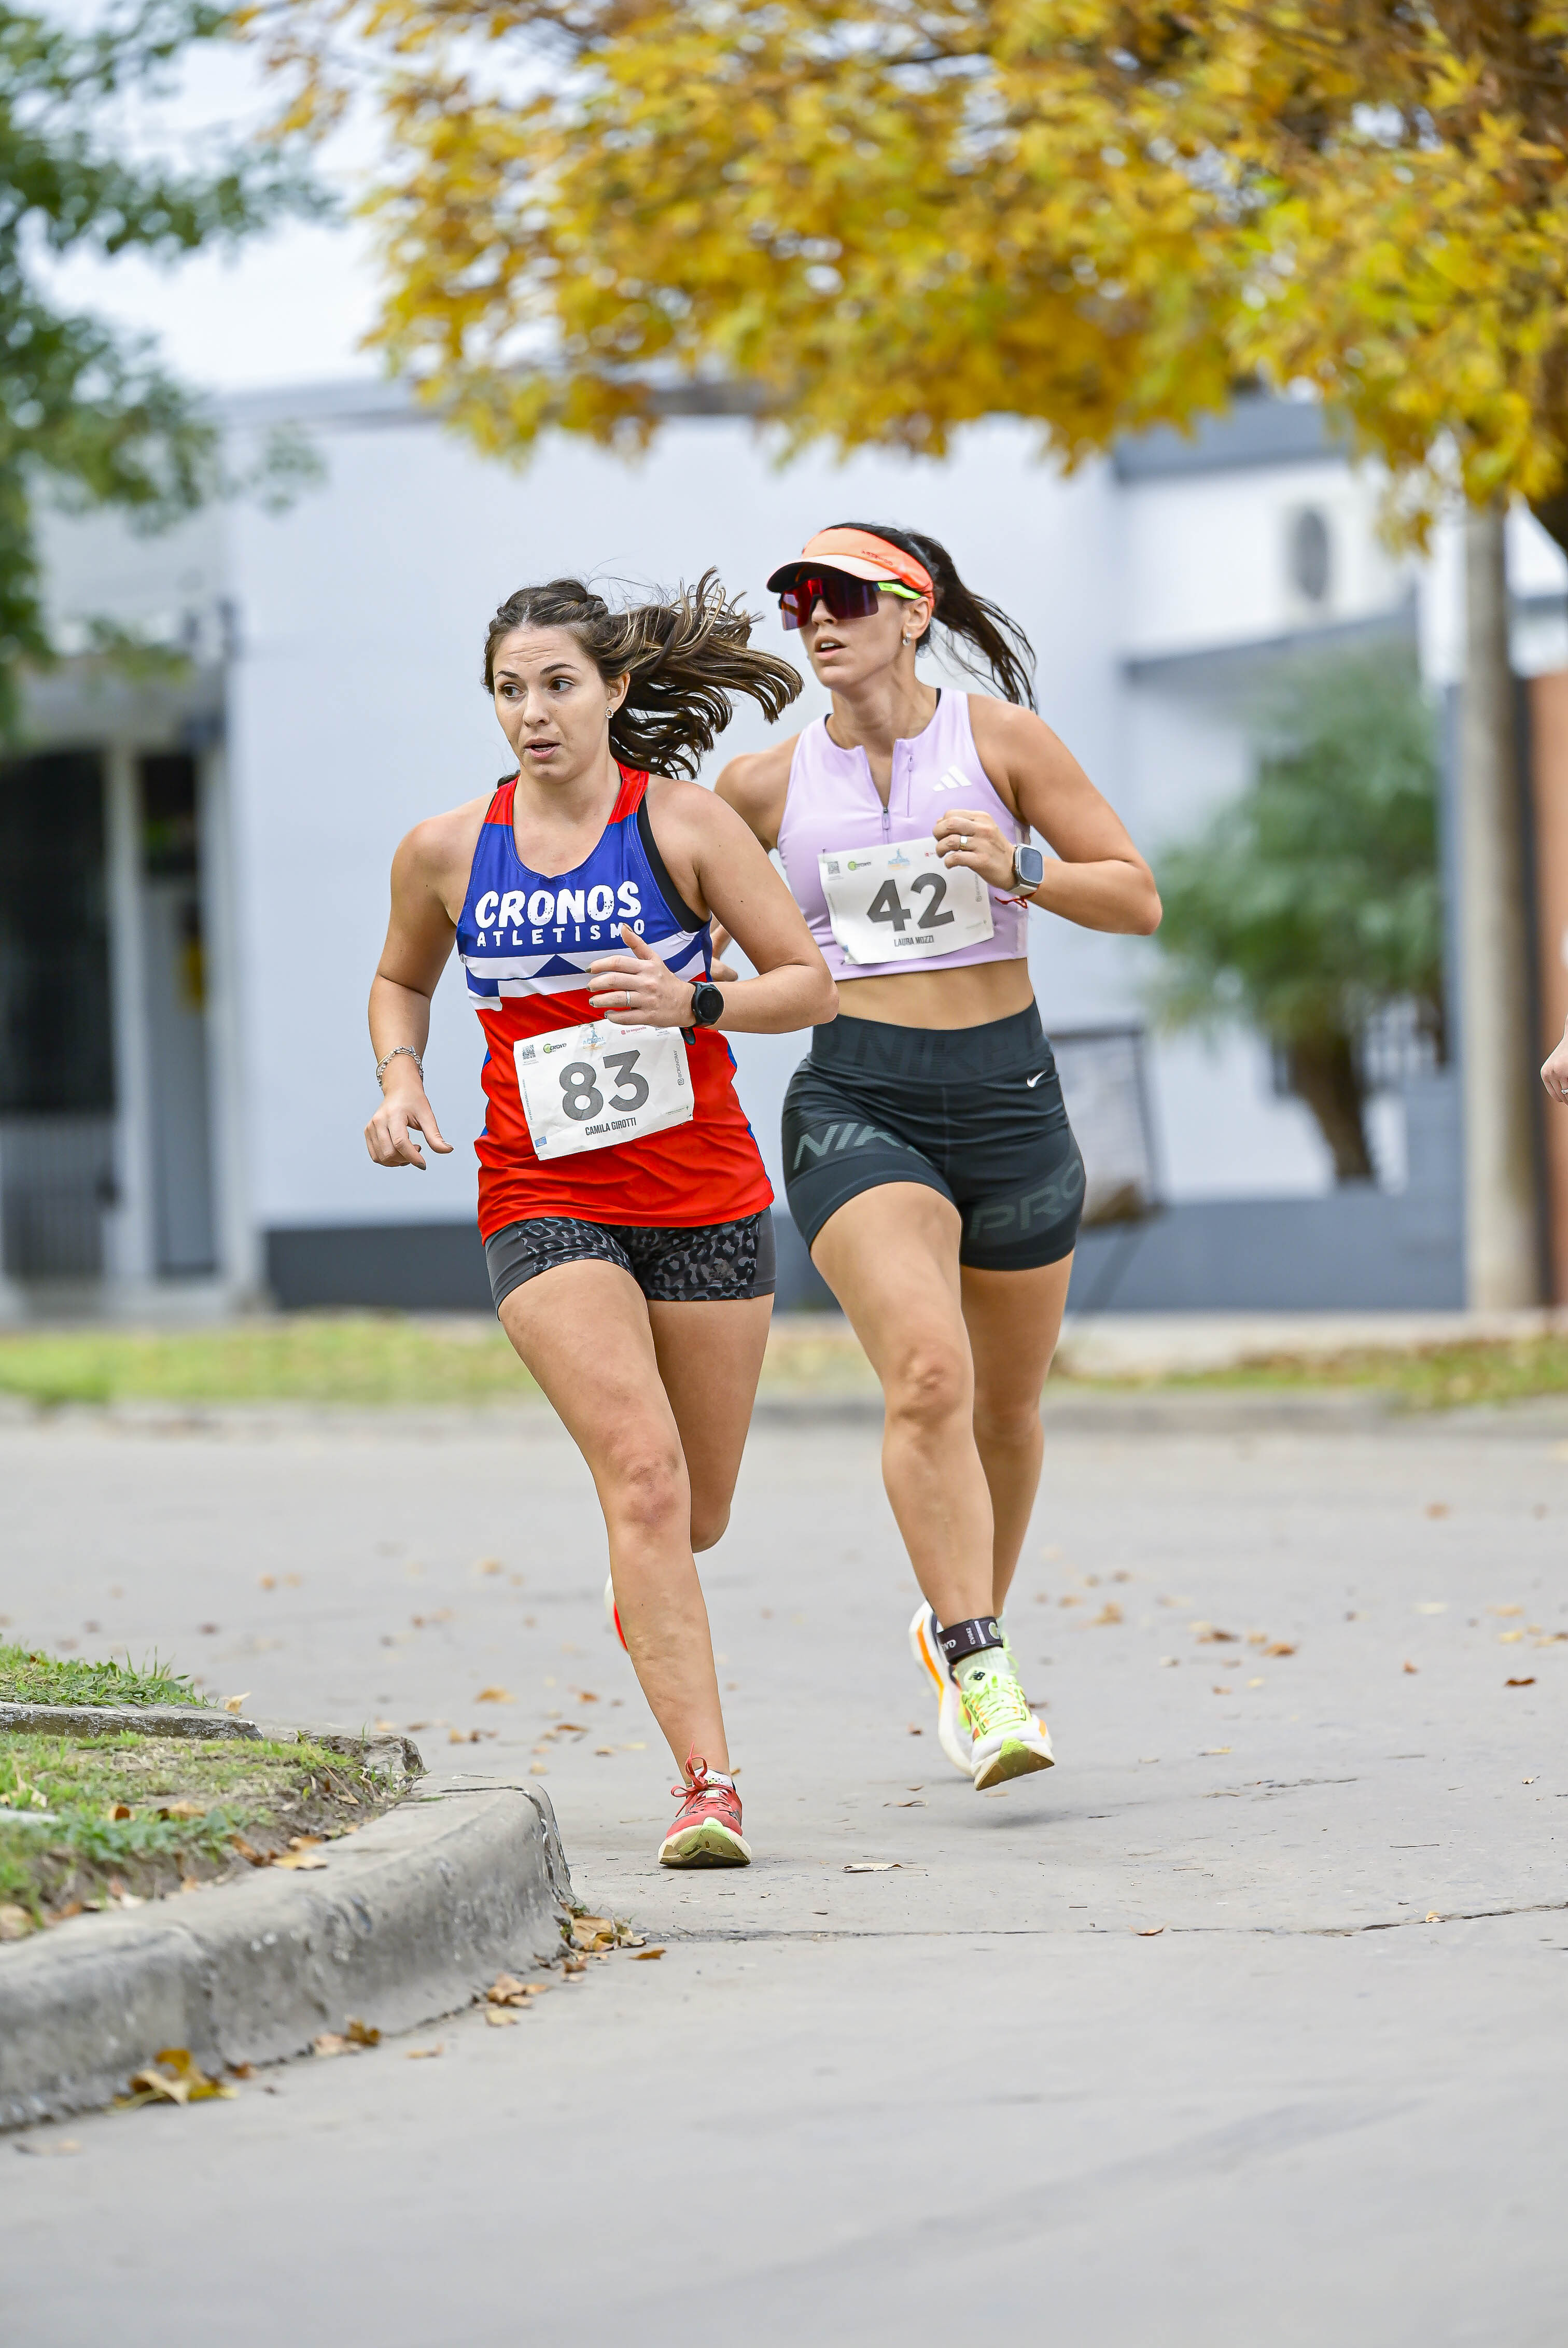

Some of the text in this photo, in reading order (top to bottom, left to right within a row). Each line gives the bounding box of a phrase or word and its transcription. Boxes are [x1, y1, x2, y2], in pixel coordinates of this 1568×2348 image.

[475, 880, 641, 929] CRONOS
[867, 873, 955, 931] 42
[477, 919, 645, 947] ATLETISMO
[894, 937, 914, 947] LAURA
[559, 1050, 649, 1121] 83
[585, 1117, 637, 1136] CAMILA GIROTTI
[793, 1122, 933, 1170] NIK
